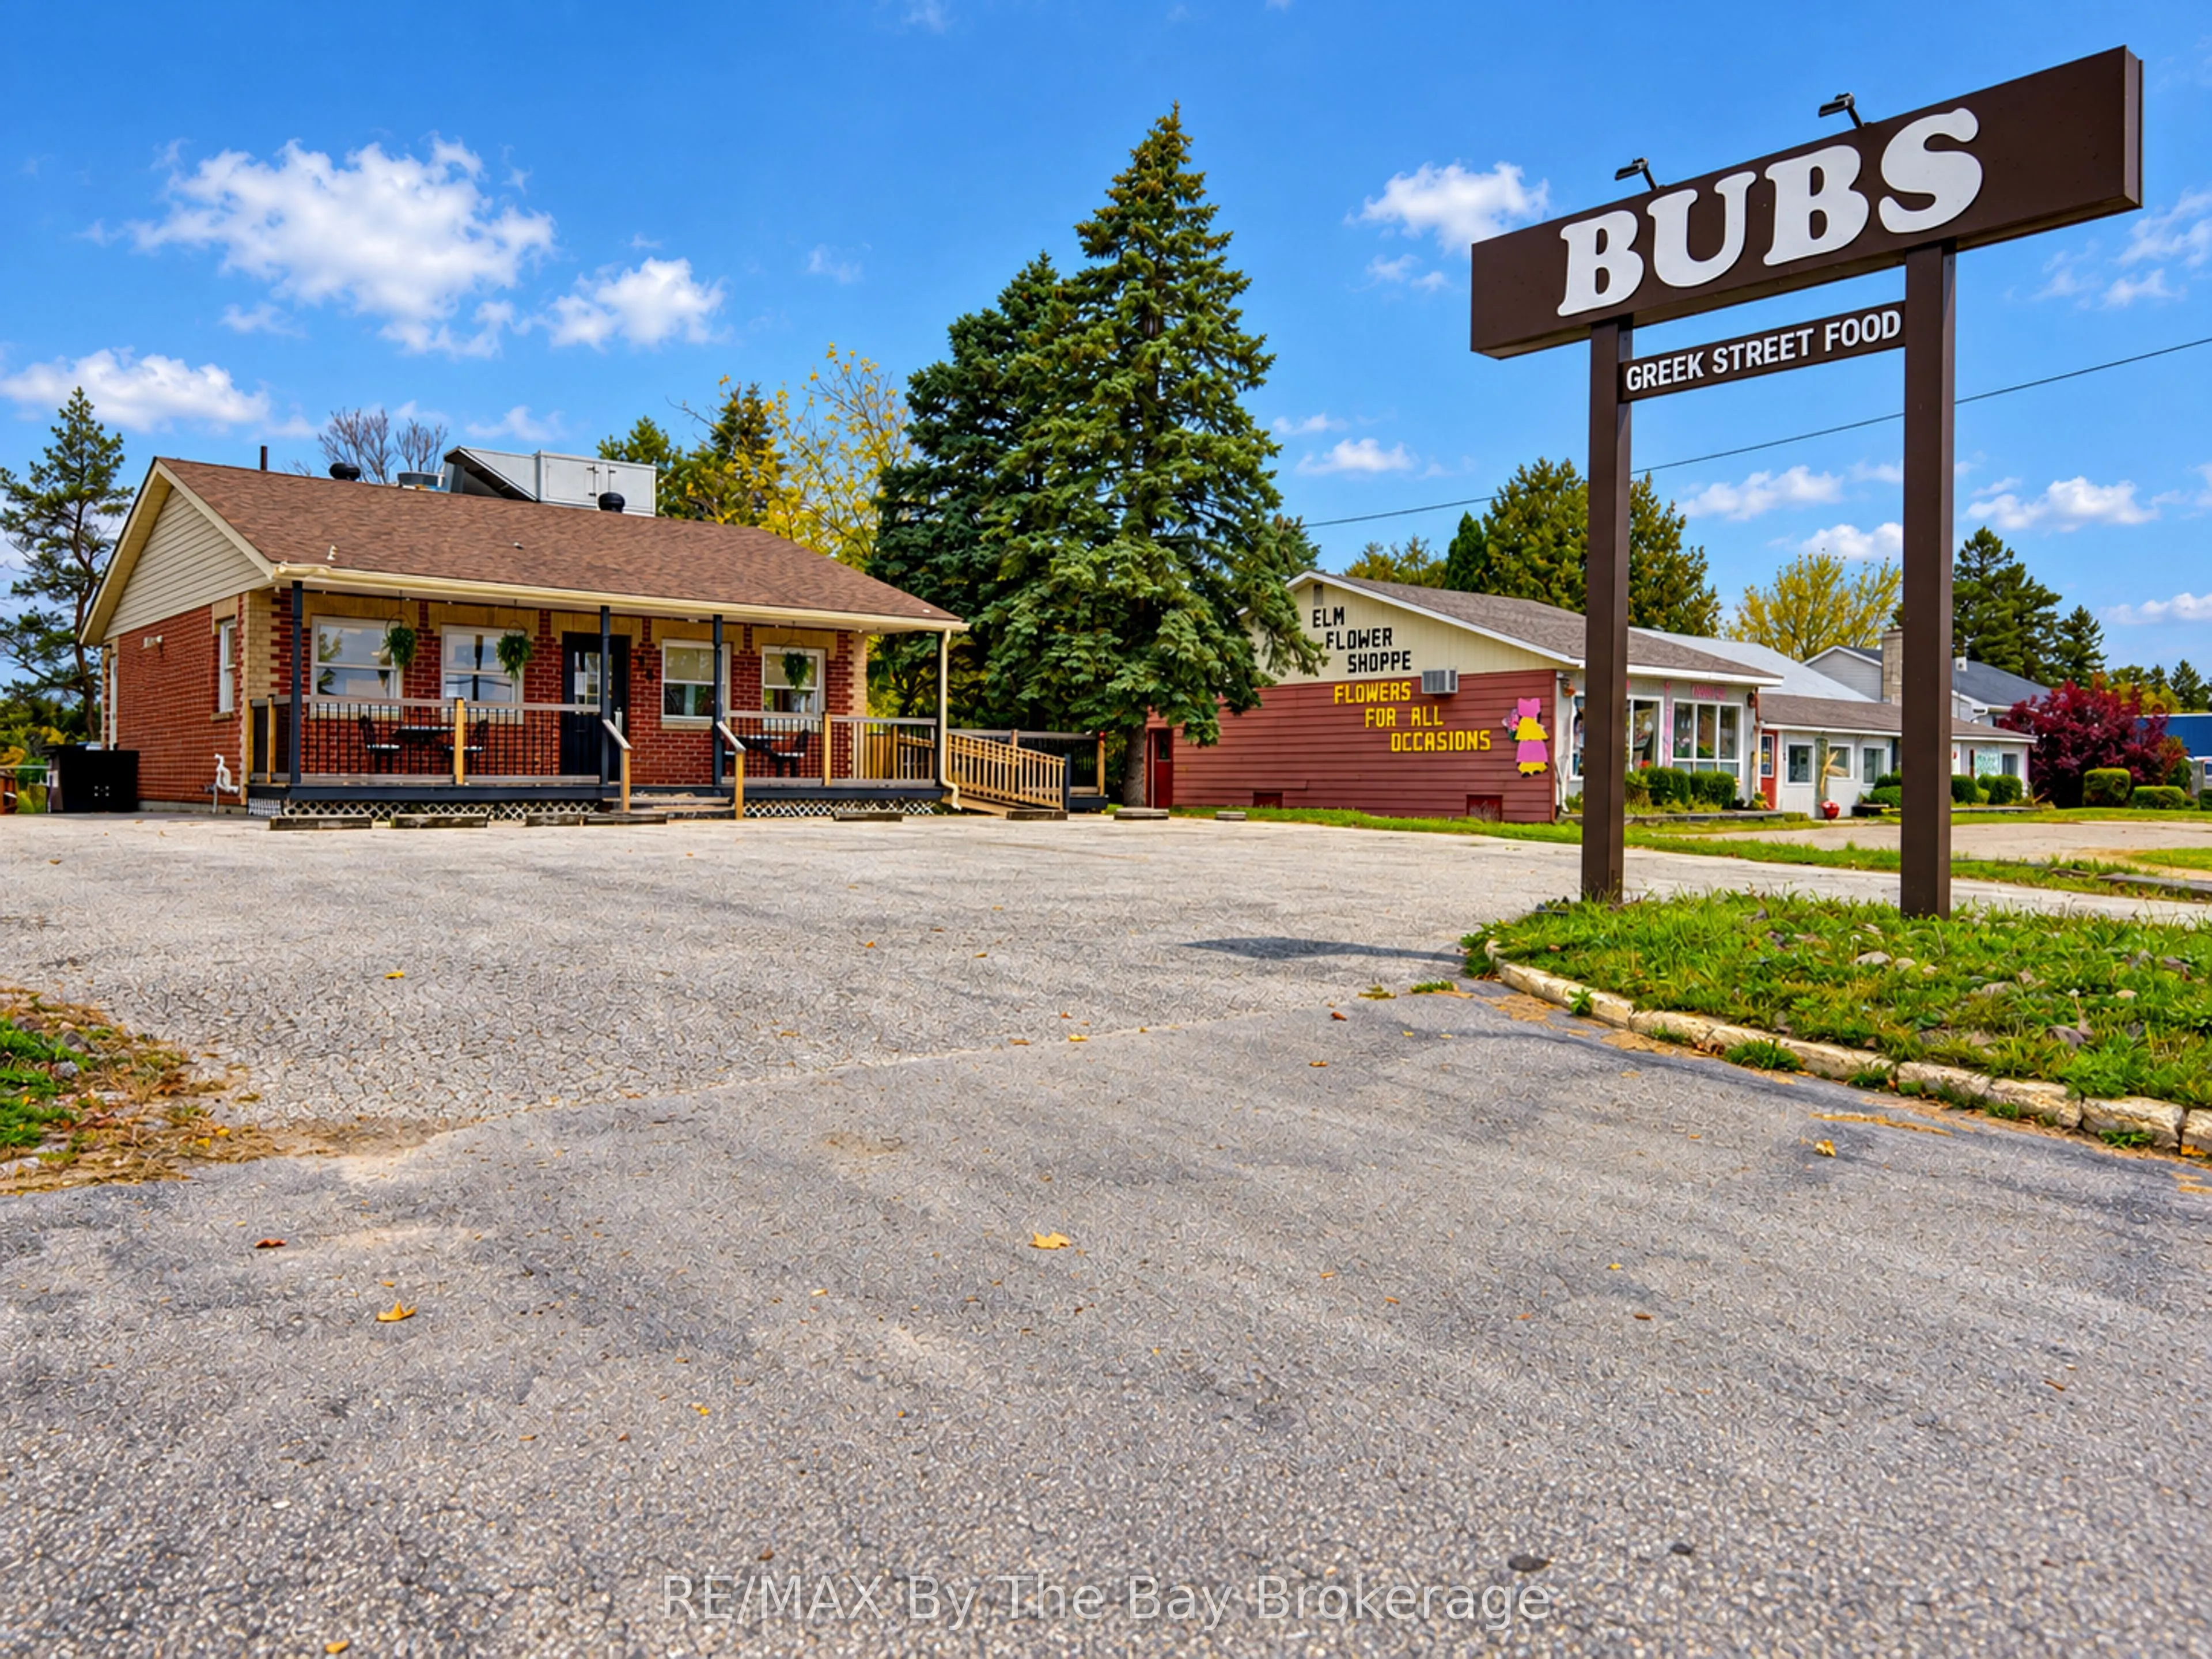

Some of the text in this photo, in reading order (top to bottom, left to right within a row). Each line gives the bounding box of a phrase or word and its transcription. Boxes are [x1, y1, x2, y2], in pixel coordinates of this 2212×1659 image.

[1556, 108, 1983, 317] BUBS
[1626, 309, 1902, 392] GREEK STREET FOOD
[1312, 606, 1345, 628] ELM
[1325, 627, 1393, 650] FLOWER
[1347, 650, 1411, 673] SHOPPE
[1334, 681, 1412, 704] FLOWERS
[1365, 705, 1444, 728] FOR ALL
[1391, 730, 1491, 752] OCCASIONS
